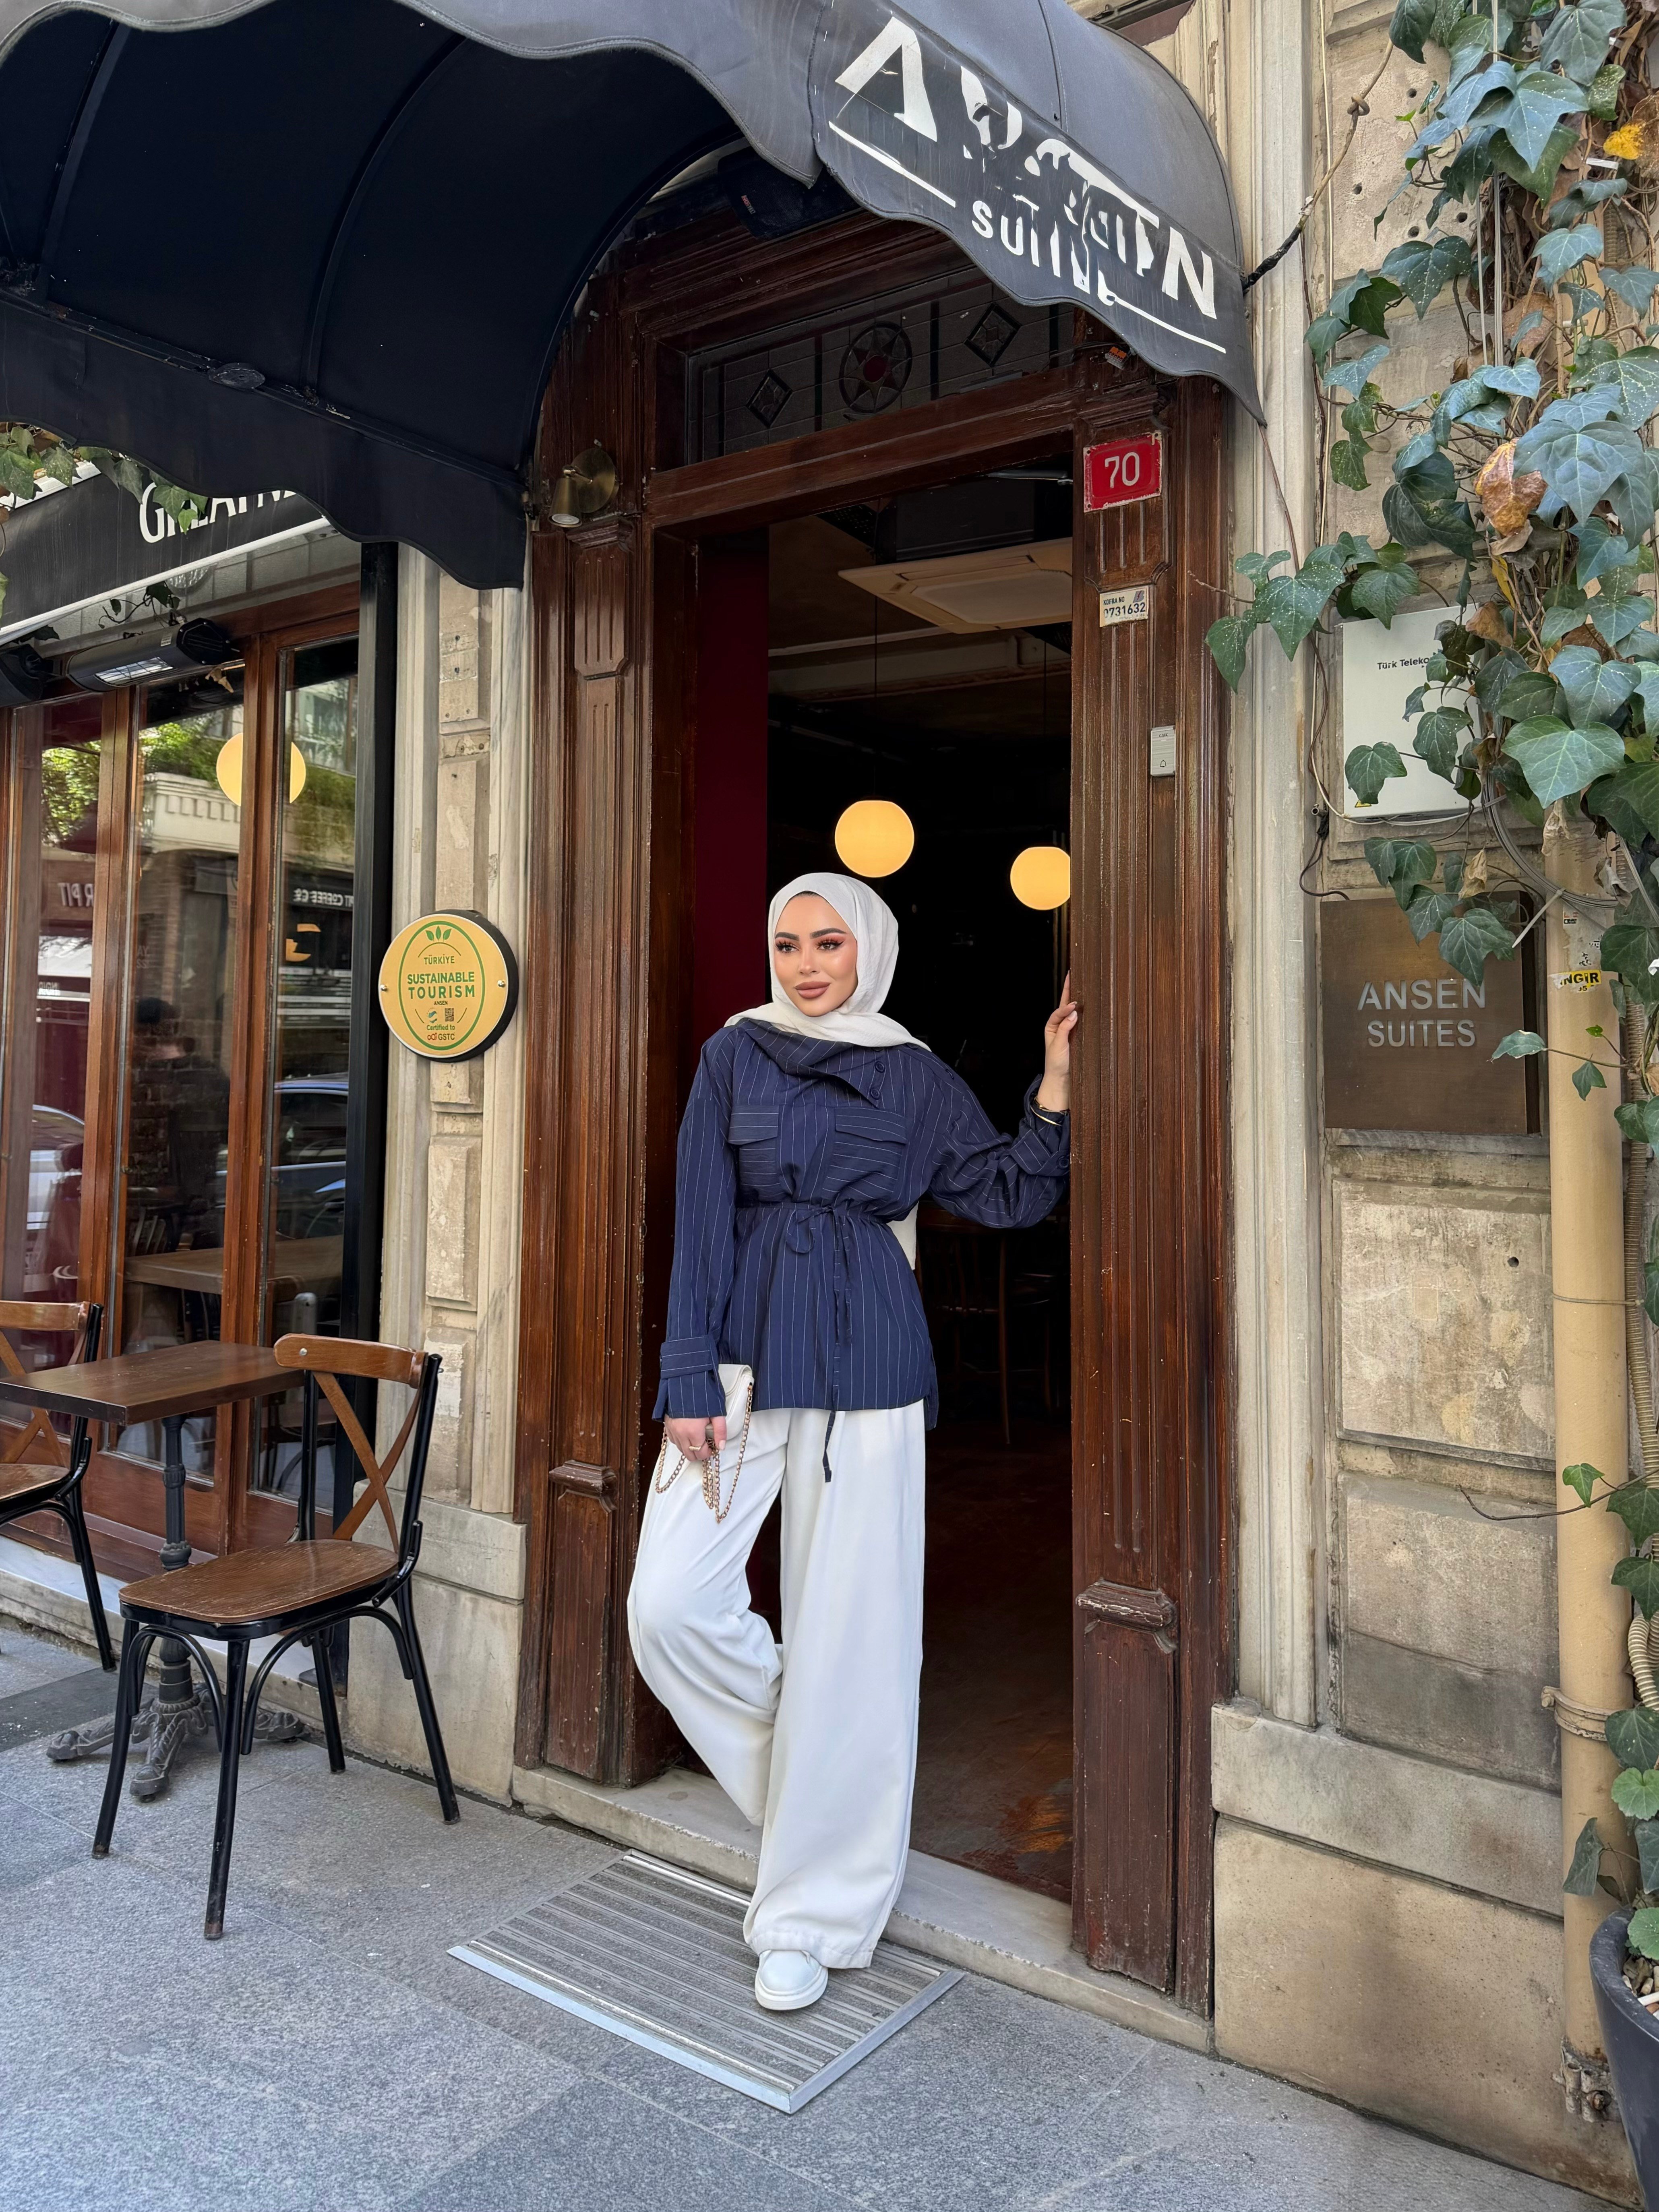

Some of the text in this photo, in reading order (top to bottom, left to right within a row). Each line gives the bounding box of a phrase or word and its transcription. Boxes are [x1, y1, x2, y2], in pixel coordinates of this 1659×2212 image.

[1104, 451, 1140, 488] 70
[1377, 657, 1430, 670] Türk Teleko
[424, 954, 455, 965] TÜRKİYE
[407, 971, 475, 984] SUSTAINABLE
[408, 985, 475, 999] TOURISM
[1357, 978, 1485, 1010] ANSEN
[1367, 1019, 1475, 1047] SUITES
